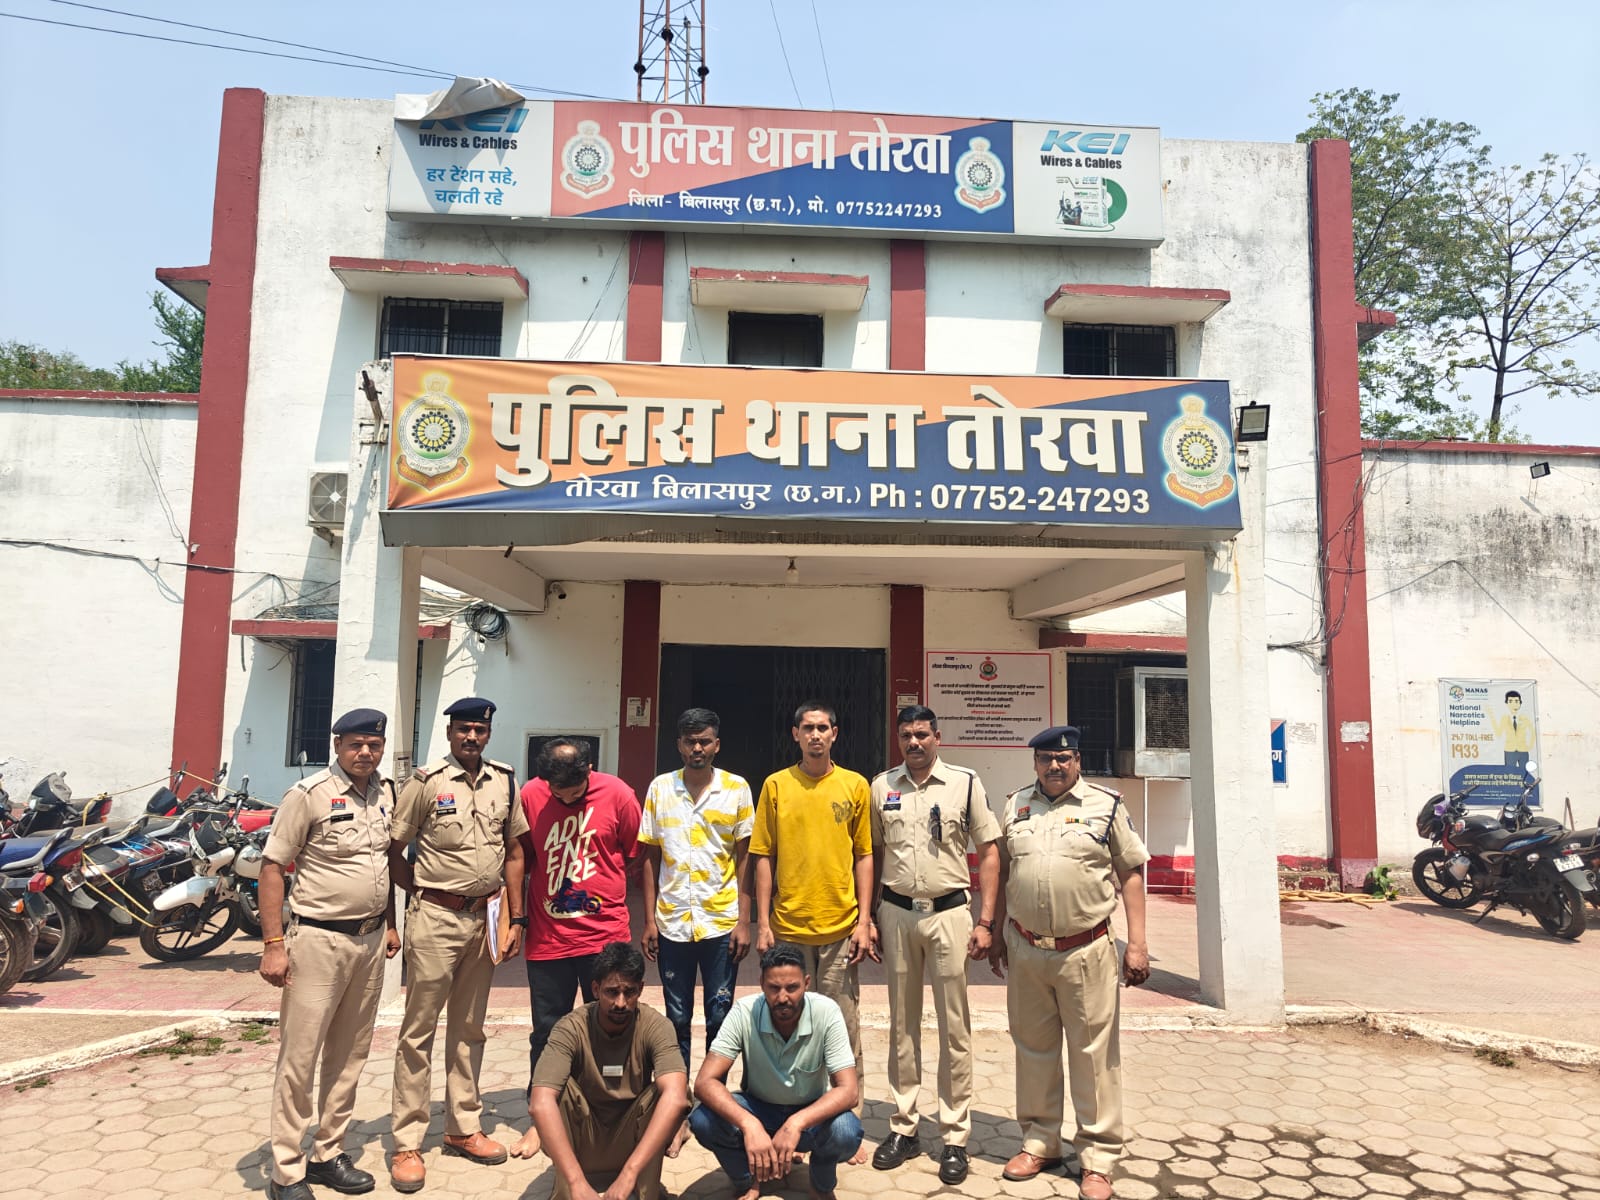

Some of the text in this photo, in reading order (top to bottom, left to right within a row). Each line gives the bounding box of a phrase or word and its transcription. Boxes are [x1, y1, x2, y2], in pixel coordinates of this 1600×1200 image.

[419, 134, 518, 150] Wires & Cables
[618, 108, 952, 178] पुलिस थाना तोरवा
[1040, 129, 1132, 156] KEI
[1040, 155, 1123, 170] Wires & Cables
[426, 165, 518, 186] हर टेंशन सहे,
[434, 187, 504, 206] चलती रहे
[679, 190, 740, 215] बिलासपुर
[808, 195, 829, 214] मो.
[836, 201, 942, 219] 07752247293
[488, 374, 1149, 489] पुलिस थाना तोरवा
[565, 474, 640, 499] तोरवा
[652, 475, 773, 511] बिलासपुर
[784, 483, 861, 506] (छ.ग.)
[869, 483, 905, 509] Ph
[930, 484, 1151, 515] 07752-247293
[1450, 719, 1481, 727] Helpline
[1451, 743, 1480, 759] 1933
